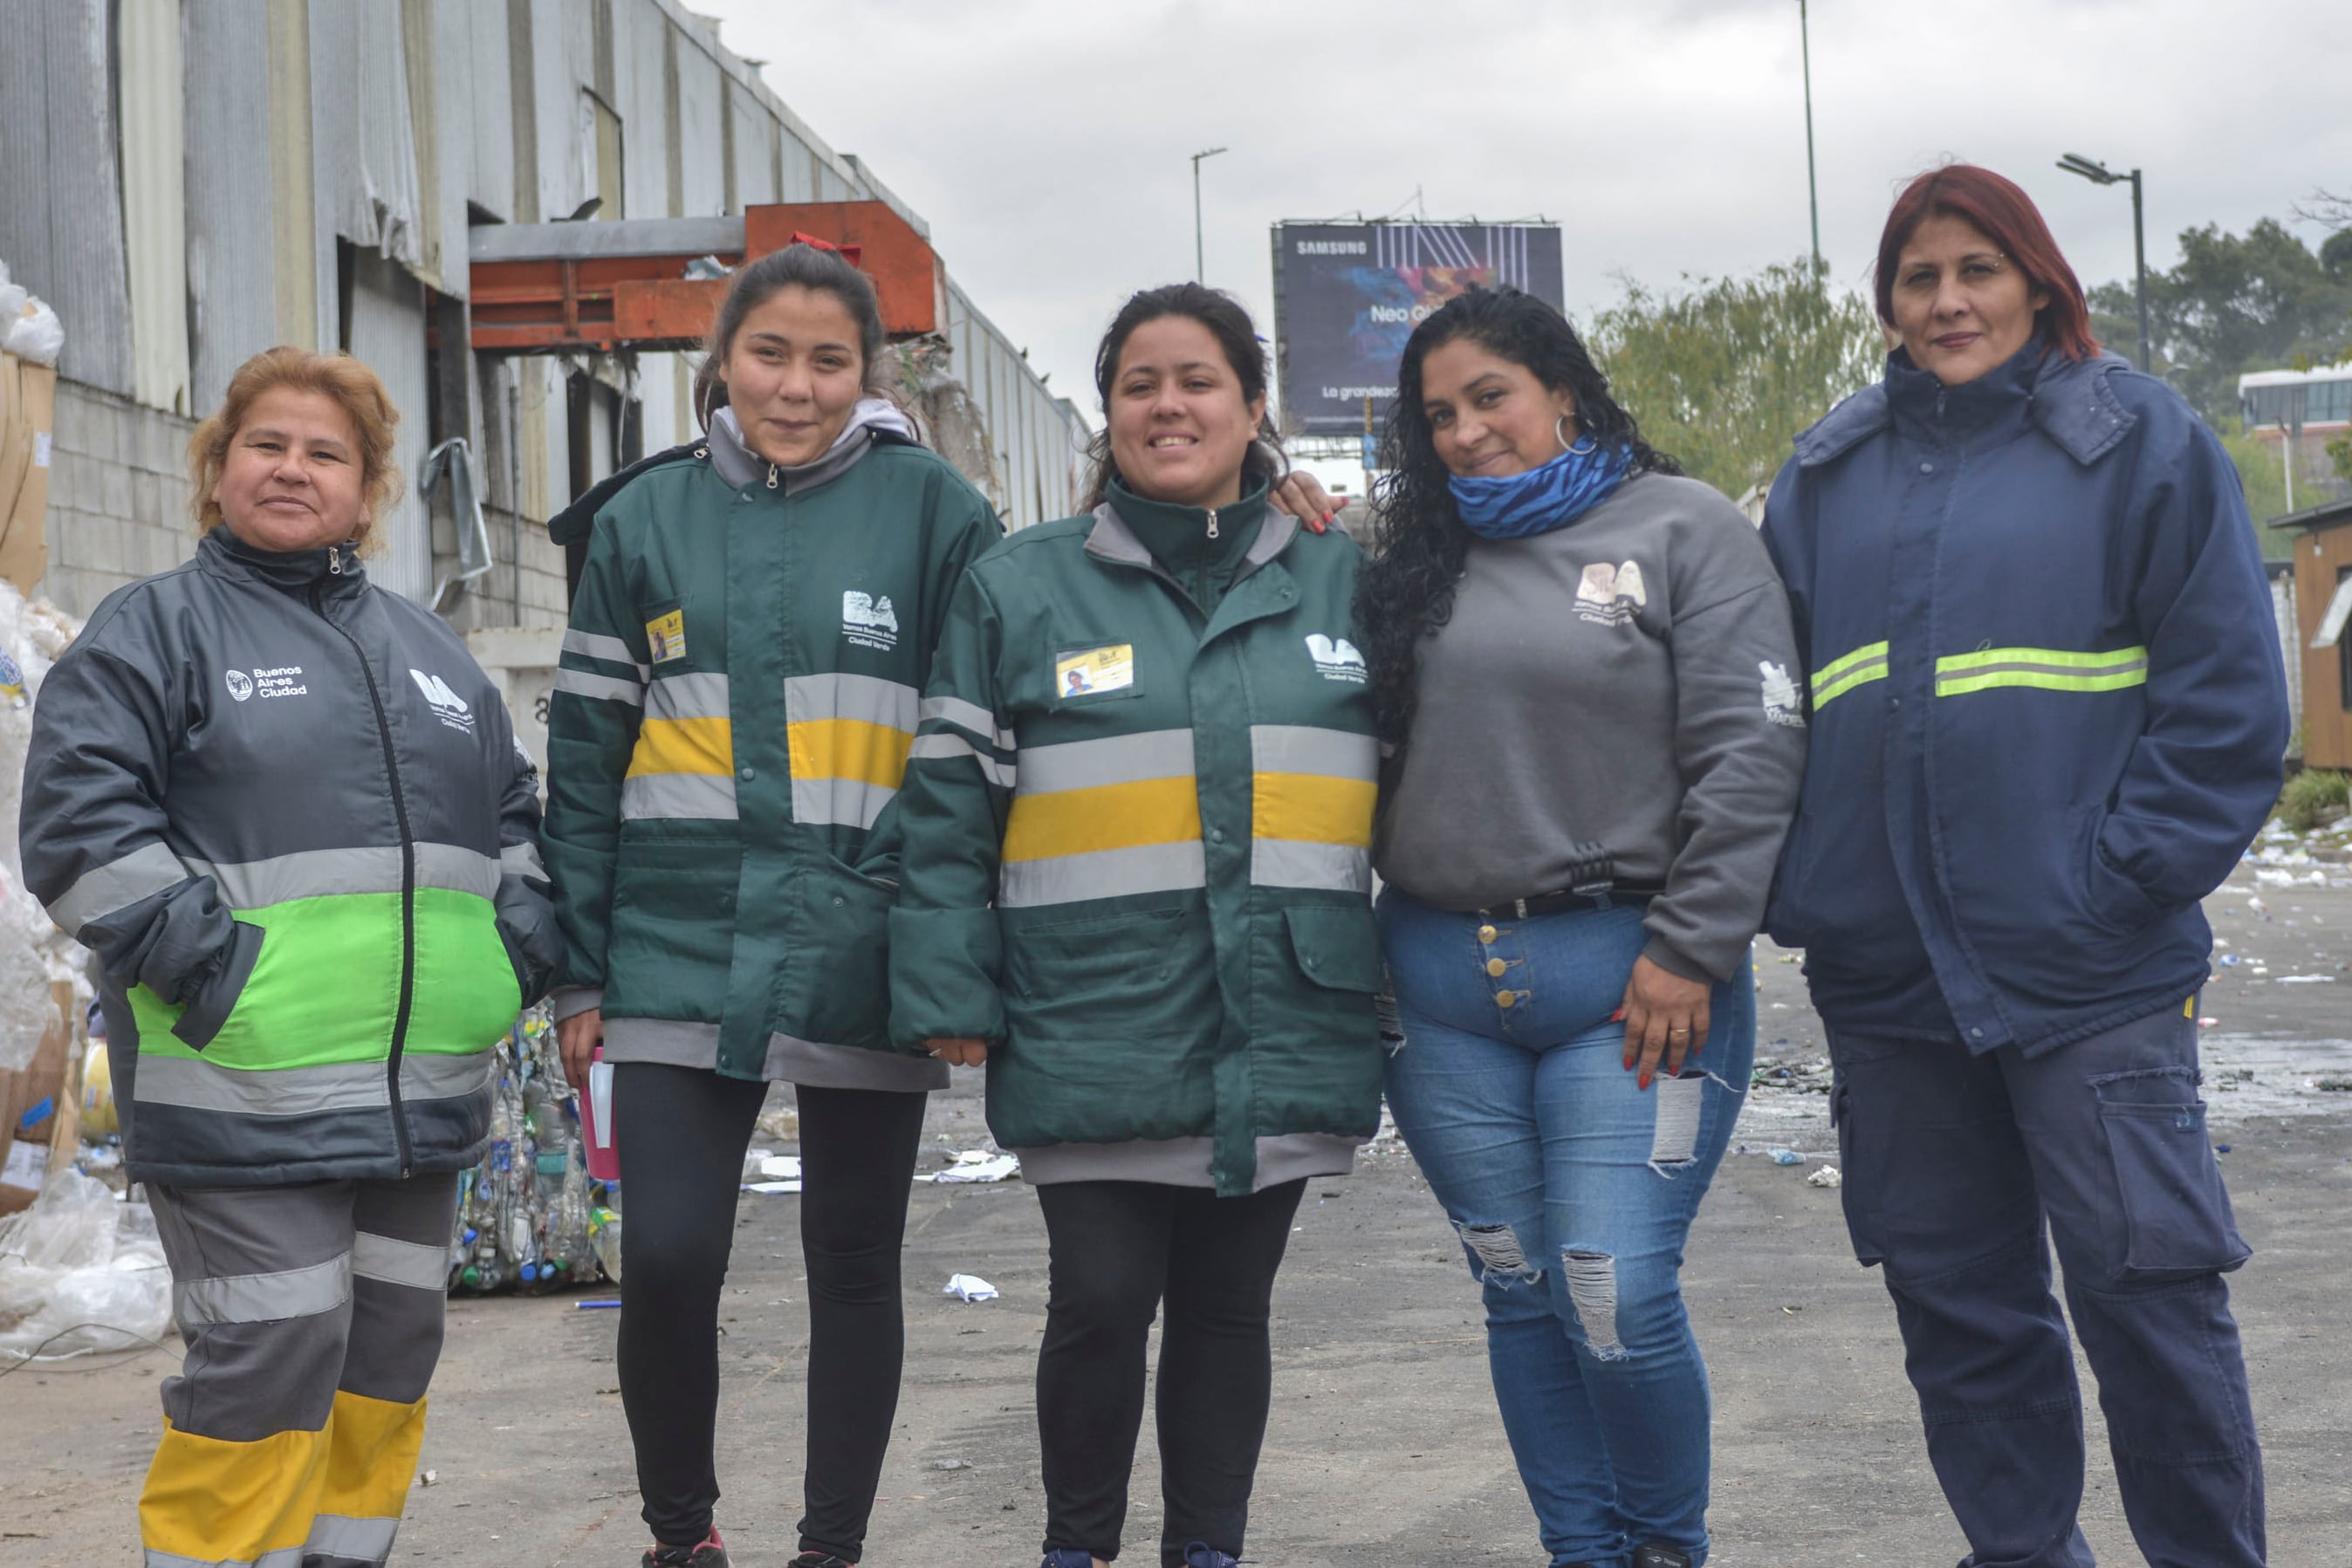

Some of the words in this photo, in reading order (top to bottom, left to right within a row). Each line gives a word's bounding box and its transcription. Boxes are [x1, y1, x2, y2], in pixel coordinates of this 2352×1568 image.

[1297, 241, 1367, 255] SAMSUNG
[1370, 305, 1409, 322] Neo
[1321, 386, 1338, 398] La
[848, 636, 873, 647] Ciudad
[253, 666, 303, 678] Buenos
[257, 677, 294, 688] Aires
[260, 684, 308, 698] Ciudad
